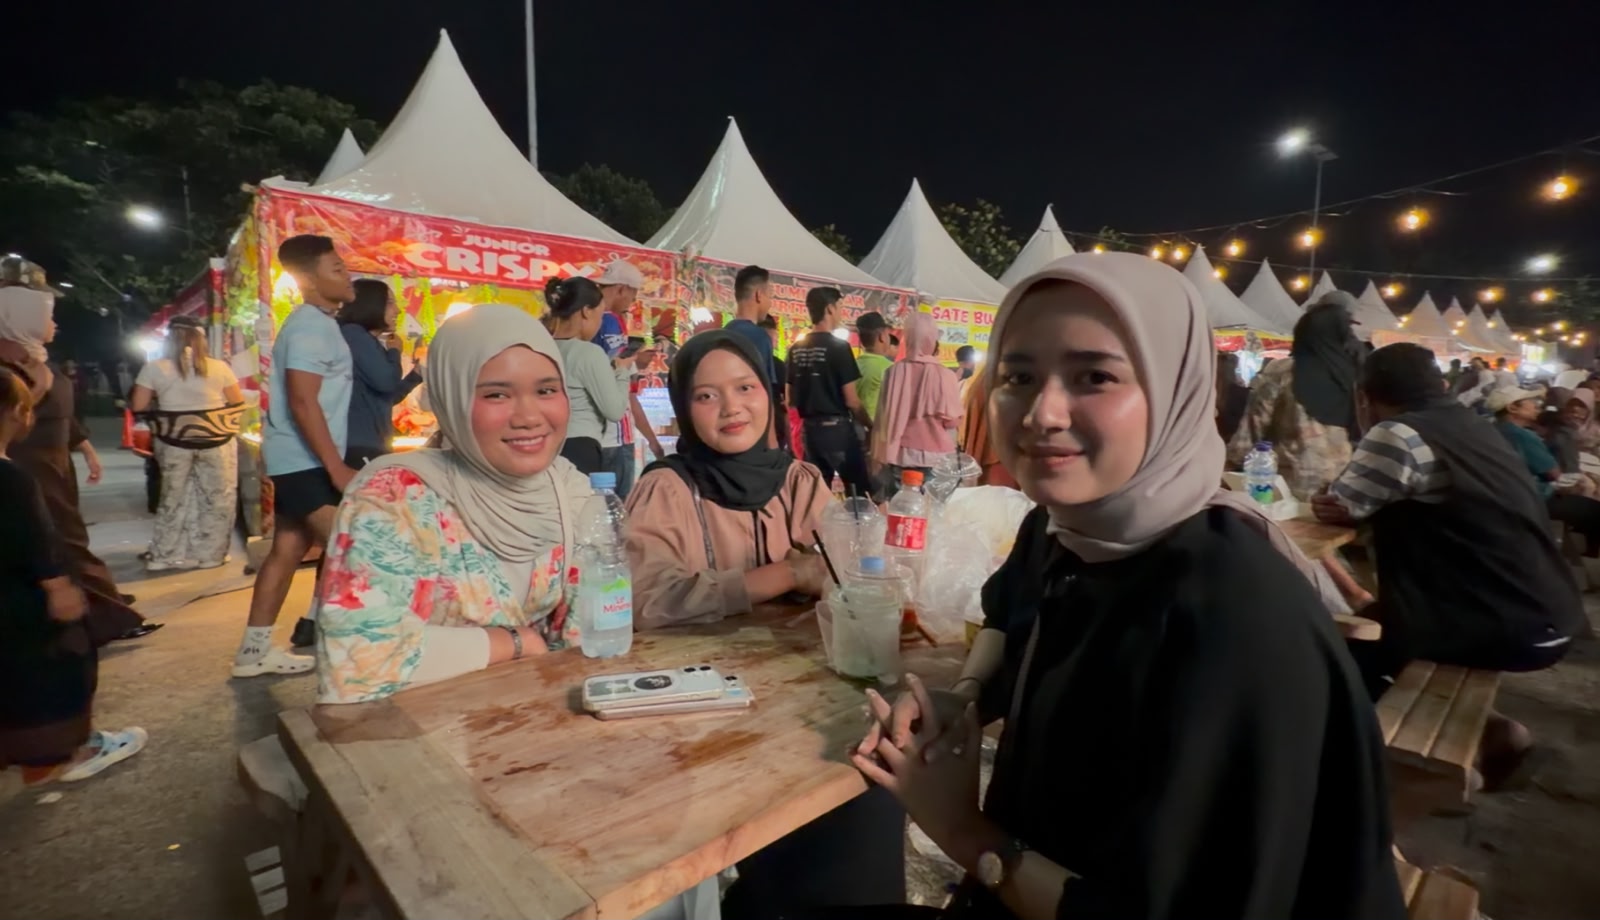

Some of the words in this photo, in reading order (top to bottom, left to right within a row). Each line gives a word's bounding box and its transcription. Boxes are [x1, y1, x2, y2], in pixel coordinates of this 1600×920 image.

[463, 234, 550, 256] JUNIOR
[403, 242, 596, 281] CRISPY
[932, 306, 968, 323] SATE
